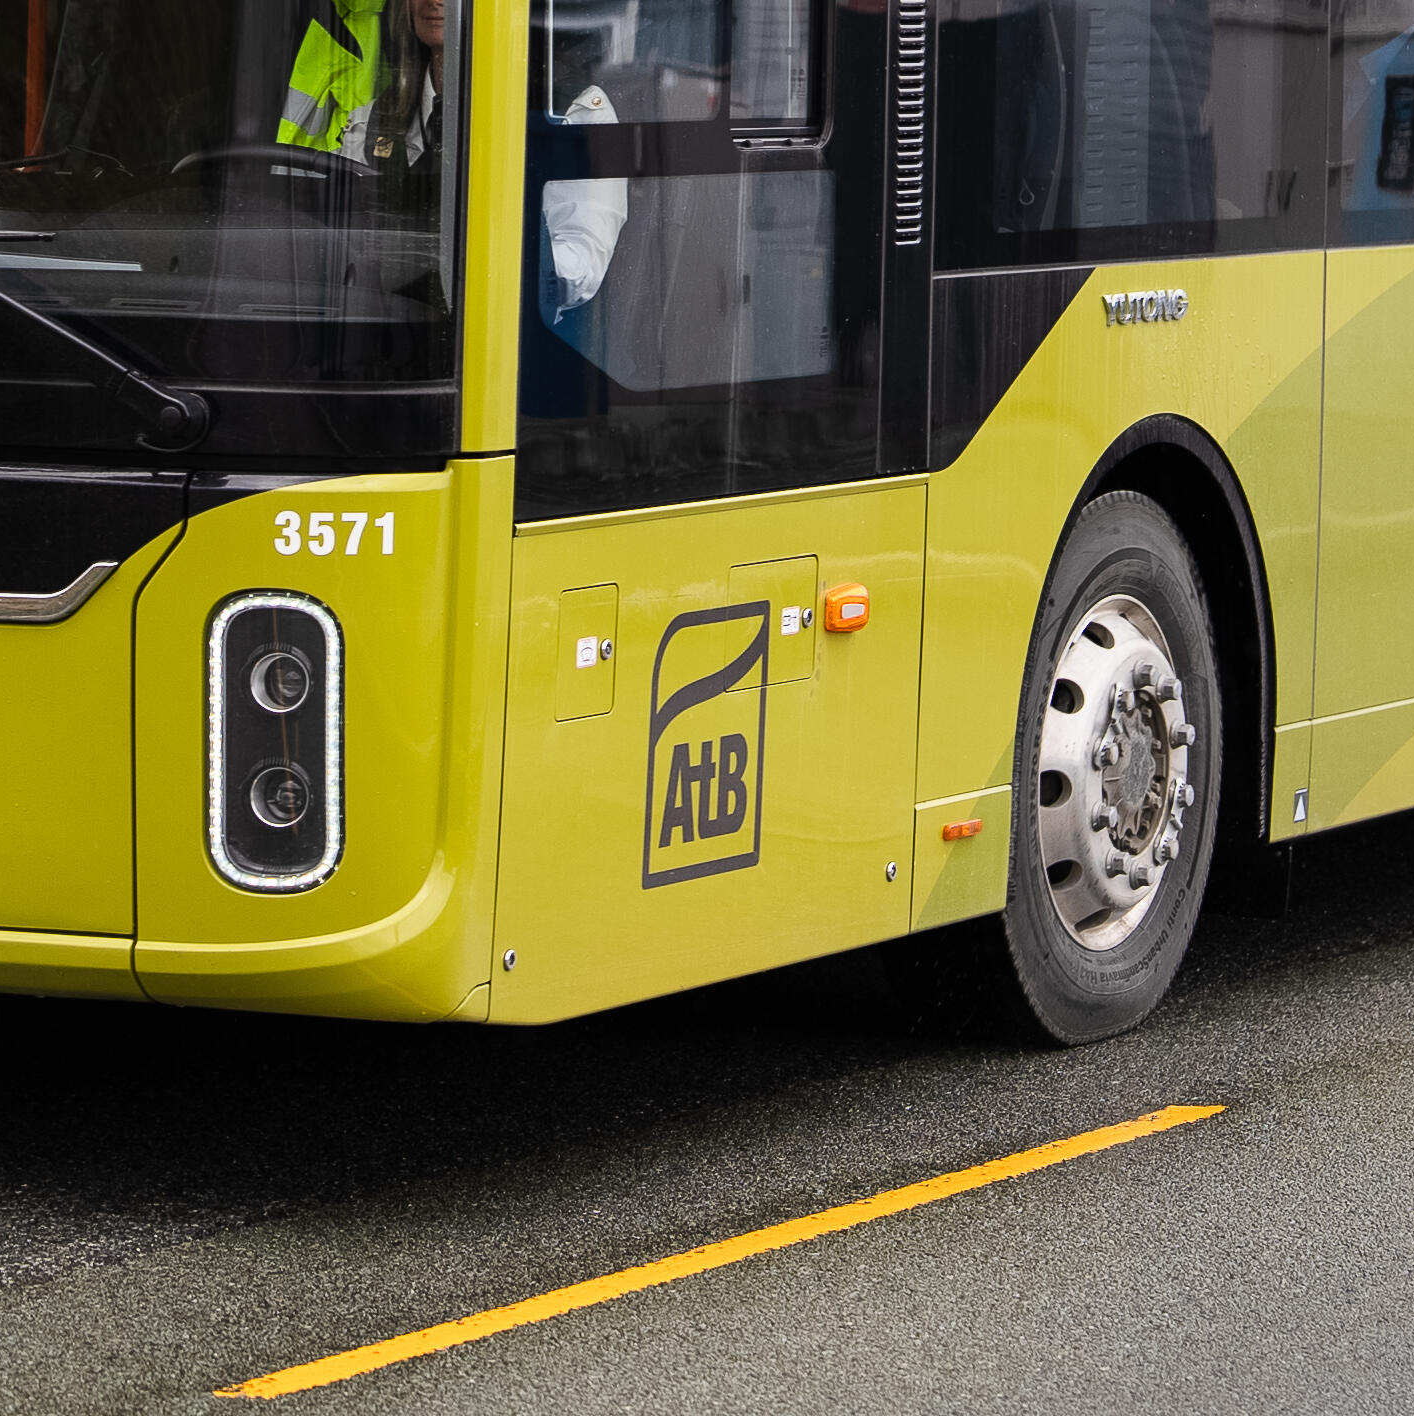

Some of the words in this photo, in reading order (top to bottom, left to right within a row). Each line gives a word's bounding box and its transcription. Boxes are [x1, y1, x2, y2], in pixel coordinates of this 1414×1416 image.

[1101, 288, 1189, 328] YUTONG
[273, 510, 396, 556] 3571
[657, 732, 749, 849] AtB
